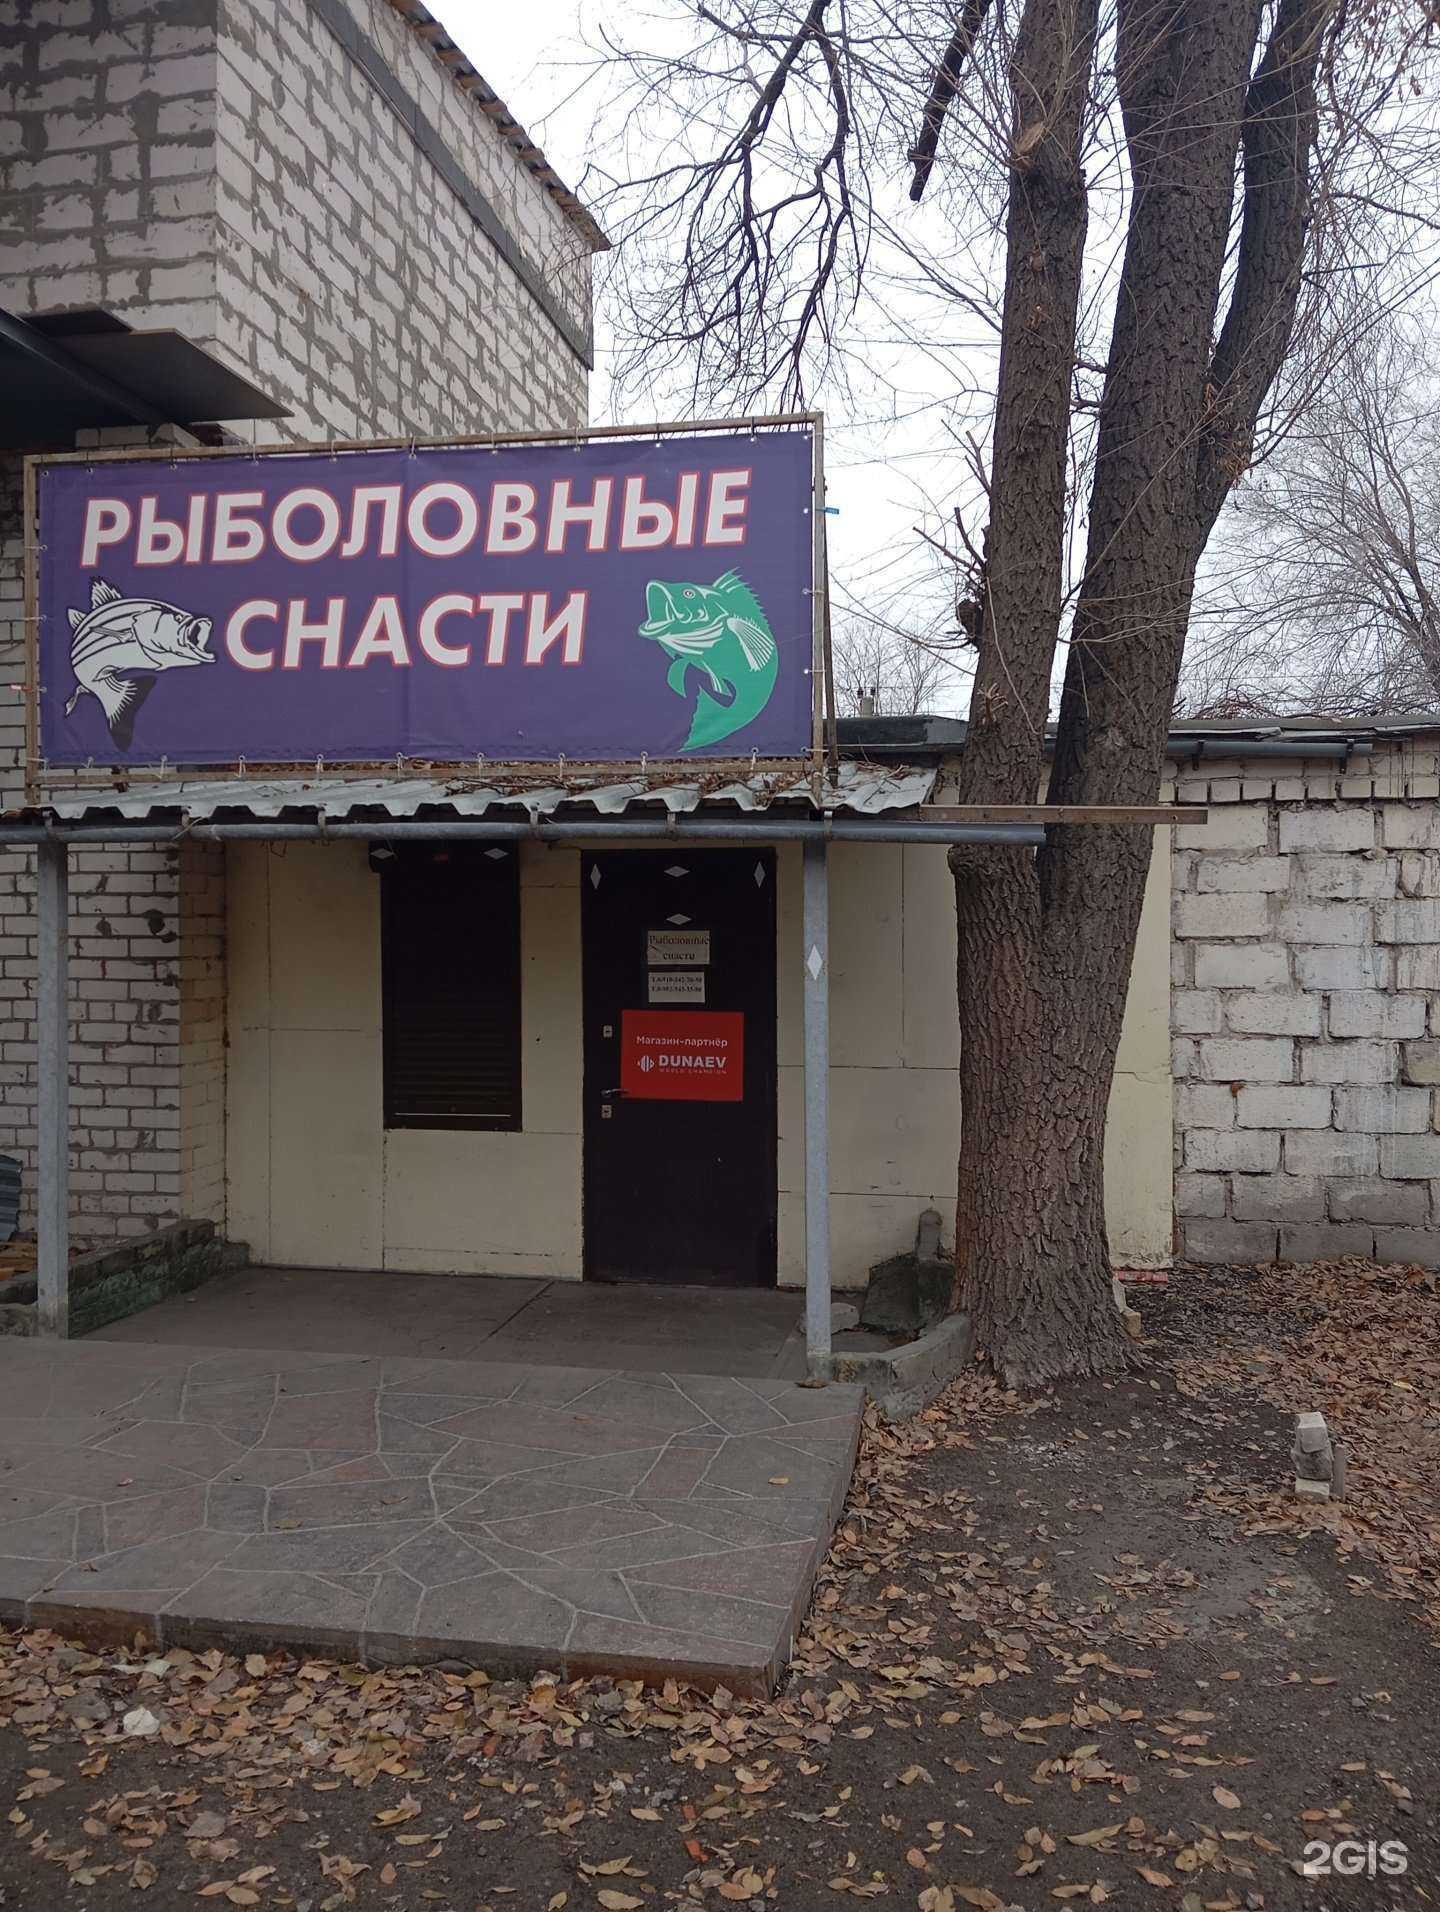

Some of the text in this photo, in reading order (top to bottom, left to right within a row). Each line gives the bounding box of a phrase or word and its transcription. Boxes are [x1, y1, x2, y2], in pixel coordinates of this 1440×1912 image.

[80, 466, 752, 567] РЫБОЛОВНЫЕ
[224, 590, 589, 670] СНАСТИ
[658, 1055, 727, 1068] DUNAEV
